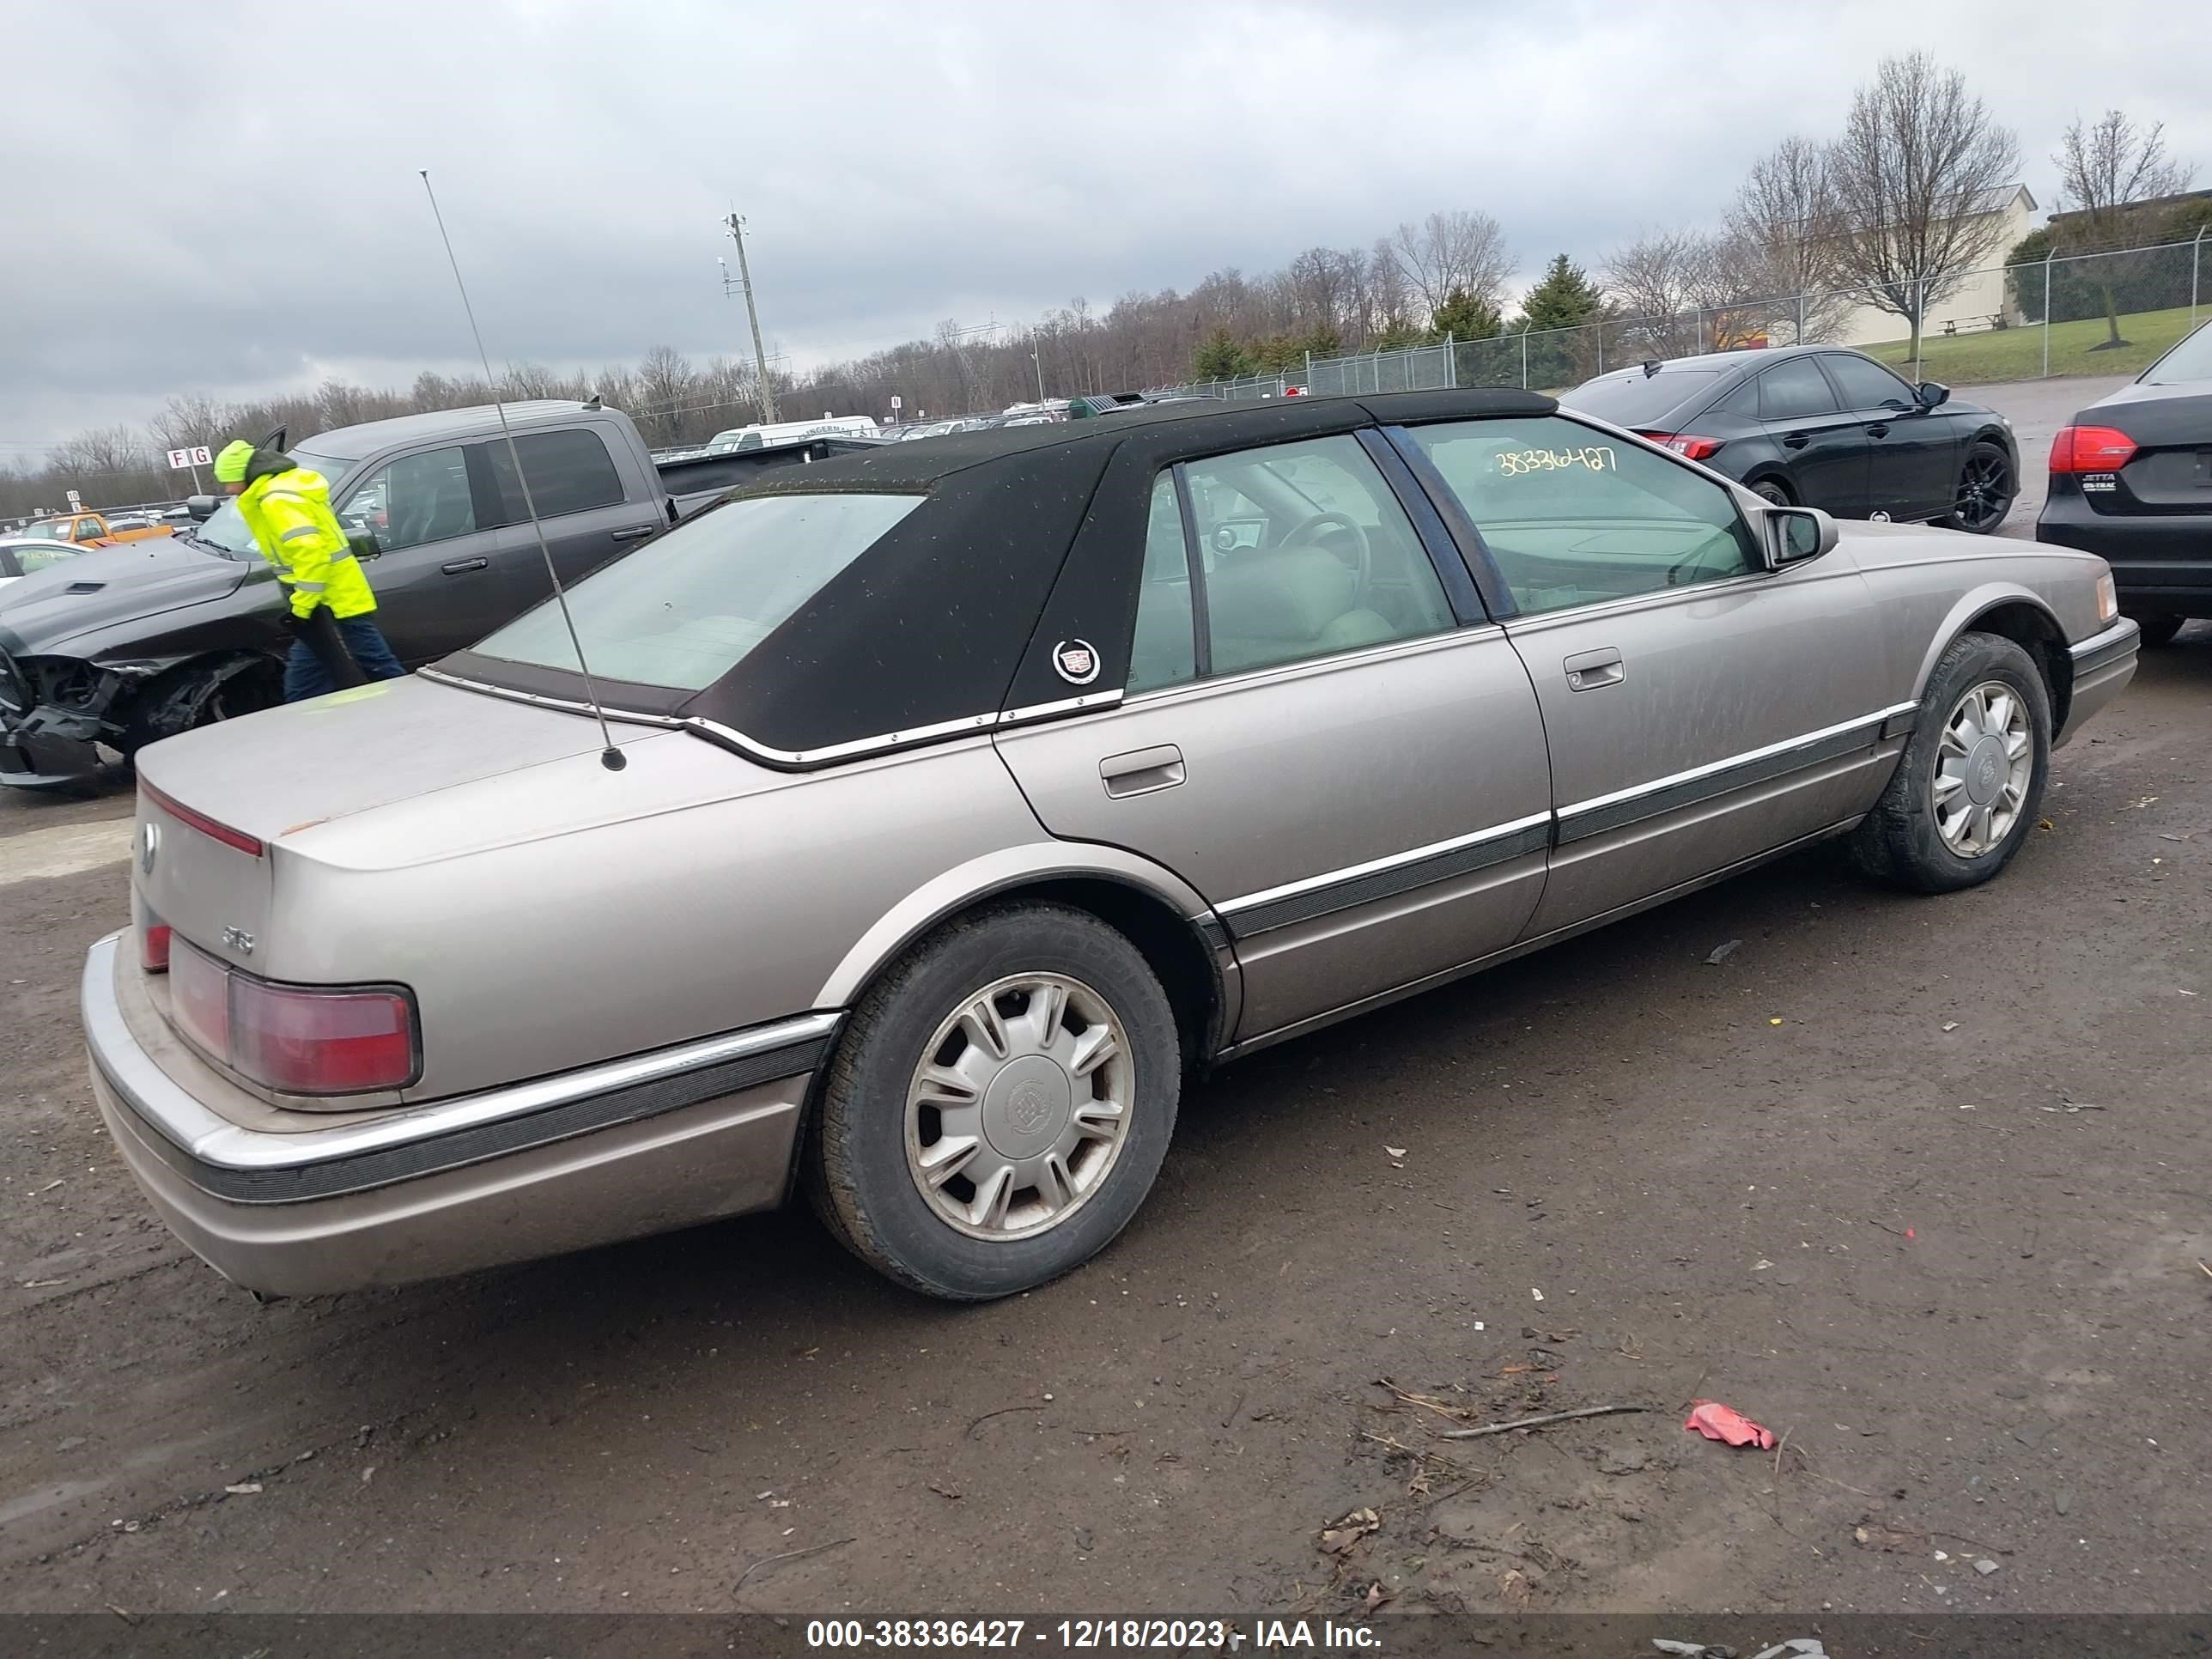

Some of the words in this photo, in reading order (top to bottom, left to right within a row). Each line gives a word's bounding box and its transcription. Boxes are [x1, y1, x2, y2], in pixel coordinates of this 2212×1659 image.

[173, 452, 183, 466] F
[196, 448, 208, 463] G
[1495, 447, 1617, 477] 38336427
[2081, 473, 2116, 482] JETTA
[68, 491, 78, 500] 10
